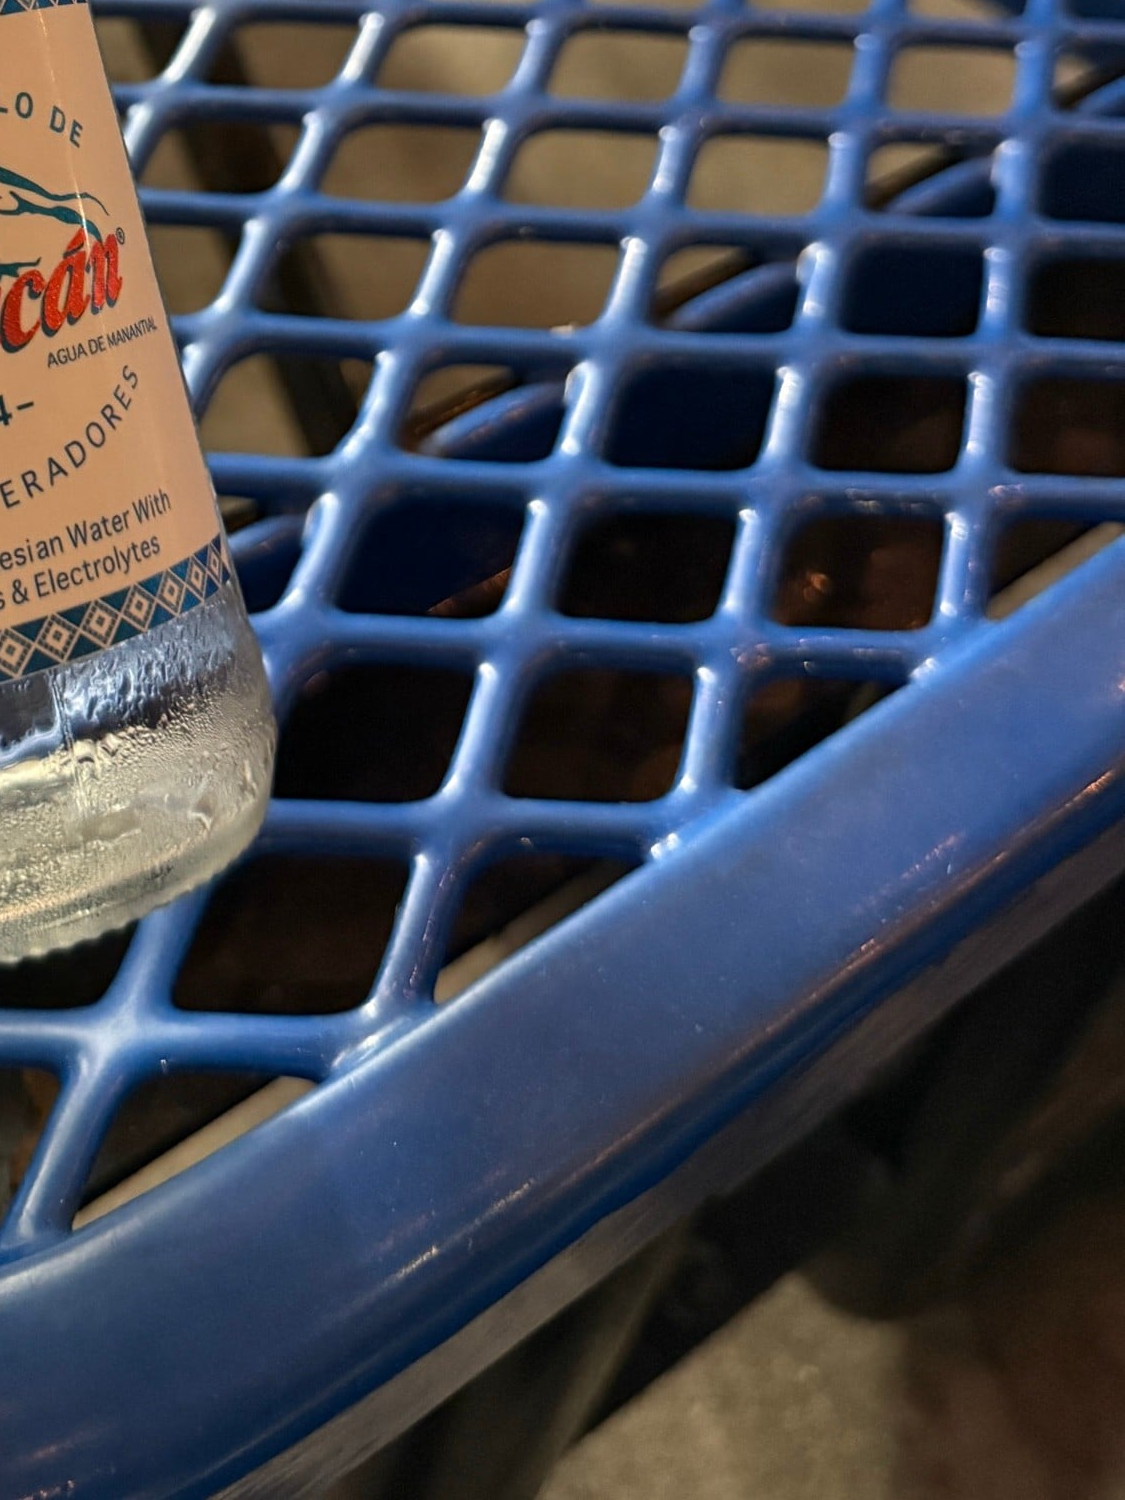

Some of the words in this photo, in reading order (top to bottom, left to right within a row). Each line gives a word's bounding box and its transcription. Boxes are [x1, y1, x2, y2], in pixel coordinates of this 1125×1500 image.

[49, 105, 84, 148] DE
[47, 343, 88, 369] AGUA
[87, 336, 107, 355] DE
[106, 316, 158, 349] MANANTIAL
[65, 506, 131, 551] Water
[131, 487, 172, 529] With
[11, 578, 30, 604] &
[33, 533, 162, 598] Electrolytes
